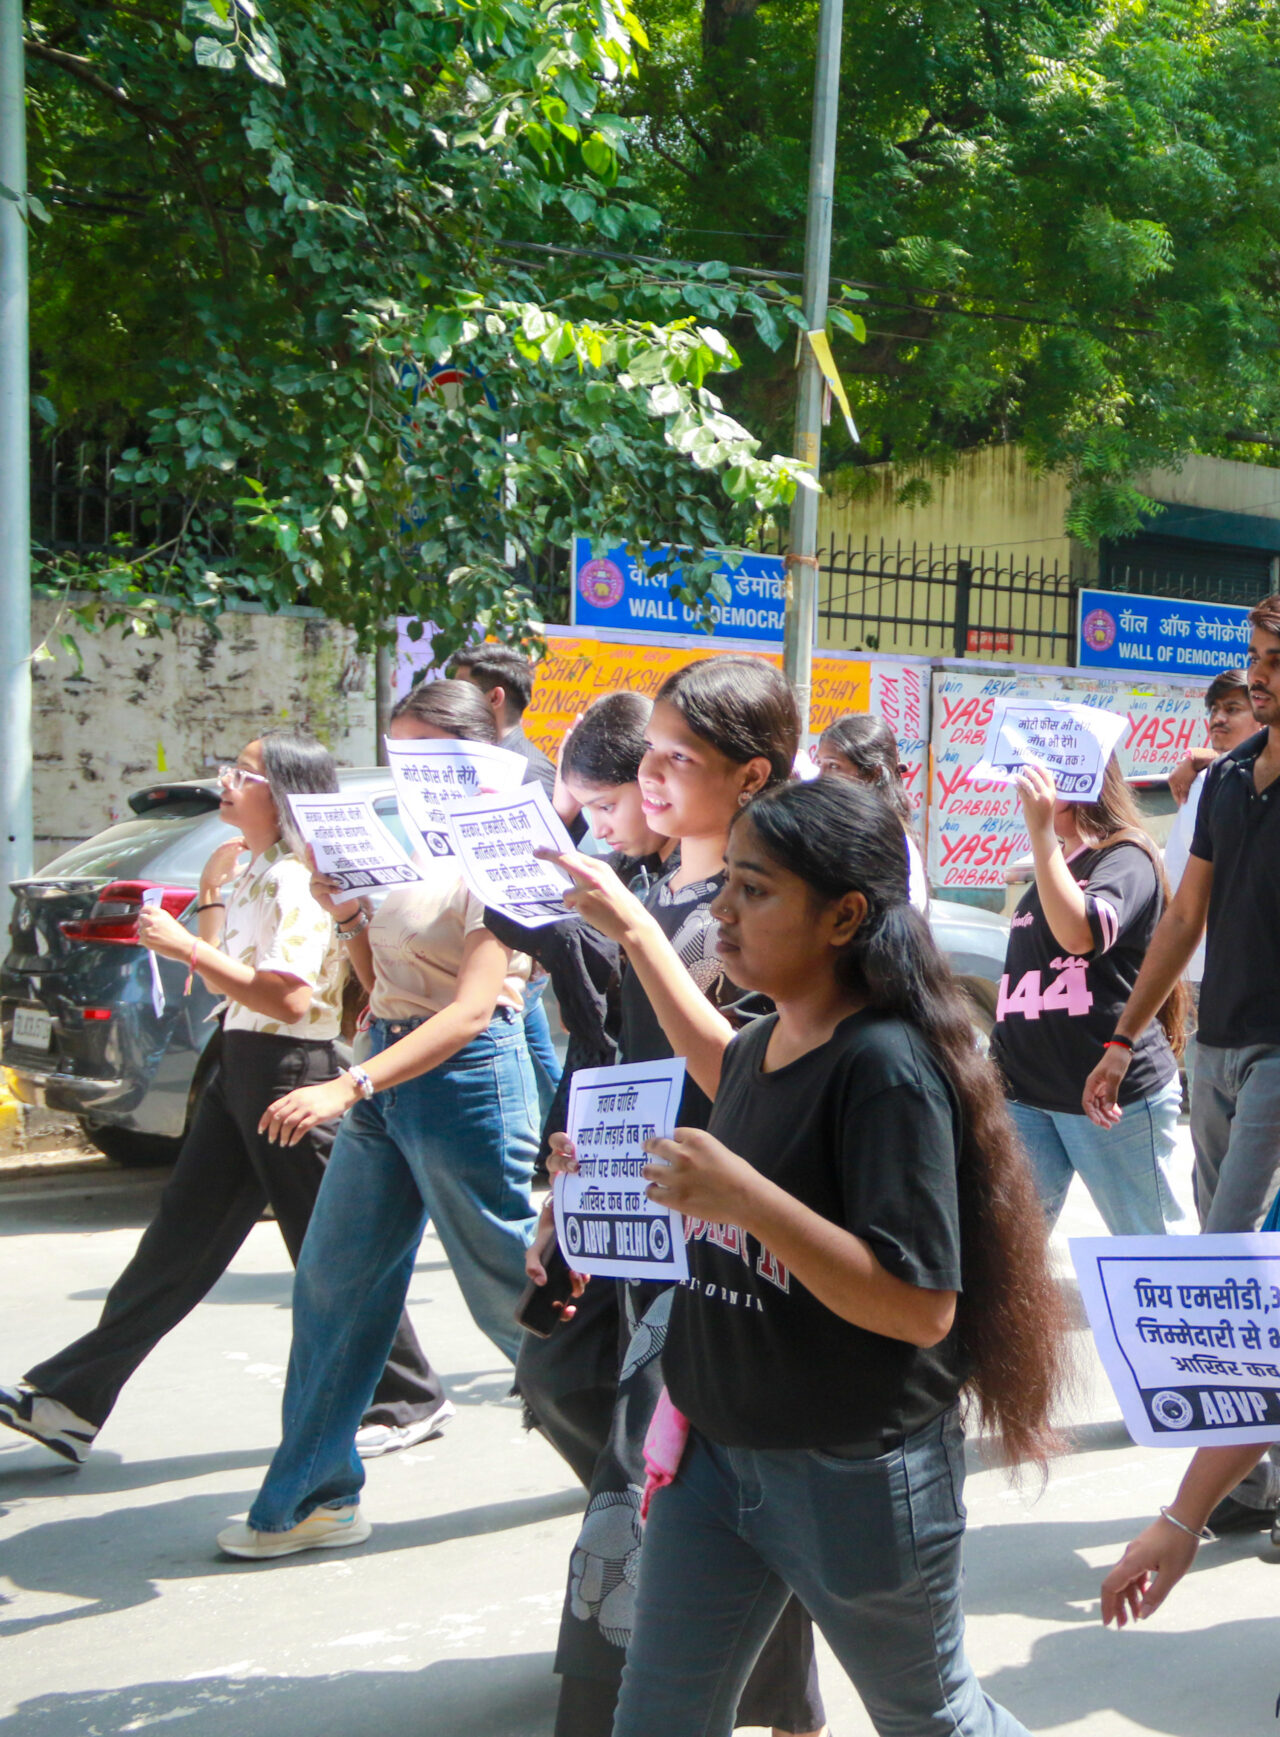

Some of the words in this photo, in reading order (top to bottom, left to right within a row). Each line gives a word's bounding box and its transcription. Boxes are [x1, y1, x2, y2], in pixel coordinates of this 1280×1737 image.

[629, 598, 678, 621] WALL
[710, 606, 785, 630] DEMOCRA
[1119, 609, 1148, 633] वॉल
[1159, 614, 1191, 637] ऑफ
[1195, 616, 1251, 644] डेमोक्रेसी
[1119, 642, 1154, 660] WALL
[1157, 645, 1173, 662] OF
[1177, 649, 1250, 669] DEMOCRACY
[593, 666, 676, 695] LAKSH
[937, 674, 963, 694] Join
[529, 688, 592, 712] SINGH
[879, 673, 899, 734] YAD
[902, 668, 920, 739] VISHES
[941, 696, 996, 729] YAS
[1129, 697, 1148, 709] Join
[1155, 699, 1191, 713] ABVP
[810, 704, 860, 724] SIN
[1018, 716, 1039, 730] मोटी
[1040, 717, 1059, 730] फीस
[1061, 718, 1074, 731] भी
[949, 727, 987, 746] DAB
[1027, 734, 1045, 747] मौत
[1125, 712, 1196, 750] YASH
[897, 739, 925, 754] BVP
[1047, 754, 1063, 764] कब
[1065, 754, 1080, 766] तक
[1053, 770, 1078, 792] ELHI
[947, 799, 1011, 816] DABAAS
[939, 834, 1010, 867] YASH
[597, 1094, 617, 1114] जवाब
[617, 1086, 639, 1111] चाहिए
[577, 1127, 594, 1146] न्याय
[593, 1121, 605, 1145] की
[604, 1119, 626, 1151] लड़ाई
[626, 1123, 640, 1144] तब
[598, 1158, 609, 1178] पर
[579, 1185, 606, 1211] आखिर
[607, 1192, 623, 1211] कब
[623, 1192, 641, 1212] तक
[582, 1219, 611, 1256] ABVP
[615, 1220, 649, 1257] DELHI
[1133, 1277, 1173, 1309] प्रिय
[1136, 1317, 1235, 1350] जिम्मेदारी
[1238, 1319, 1263, 1350] से
[1170, 1353, 1242, 1377] आखिर
[1240, 1362, 1280, 1380] कब
[1199, 1391, 1269, 1426] ABVP
